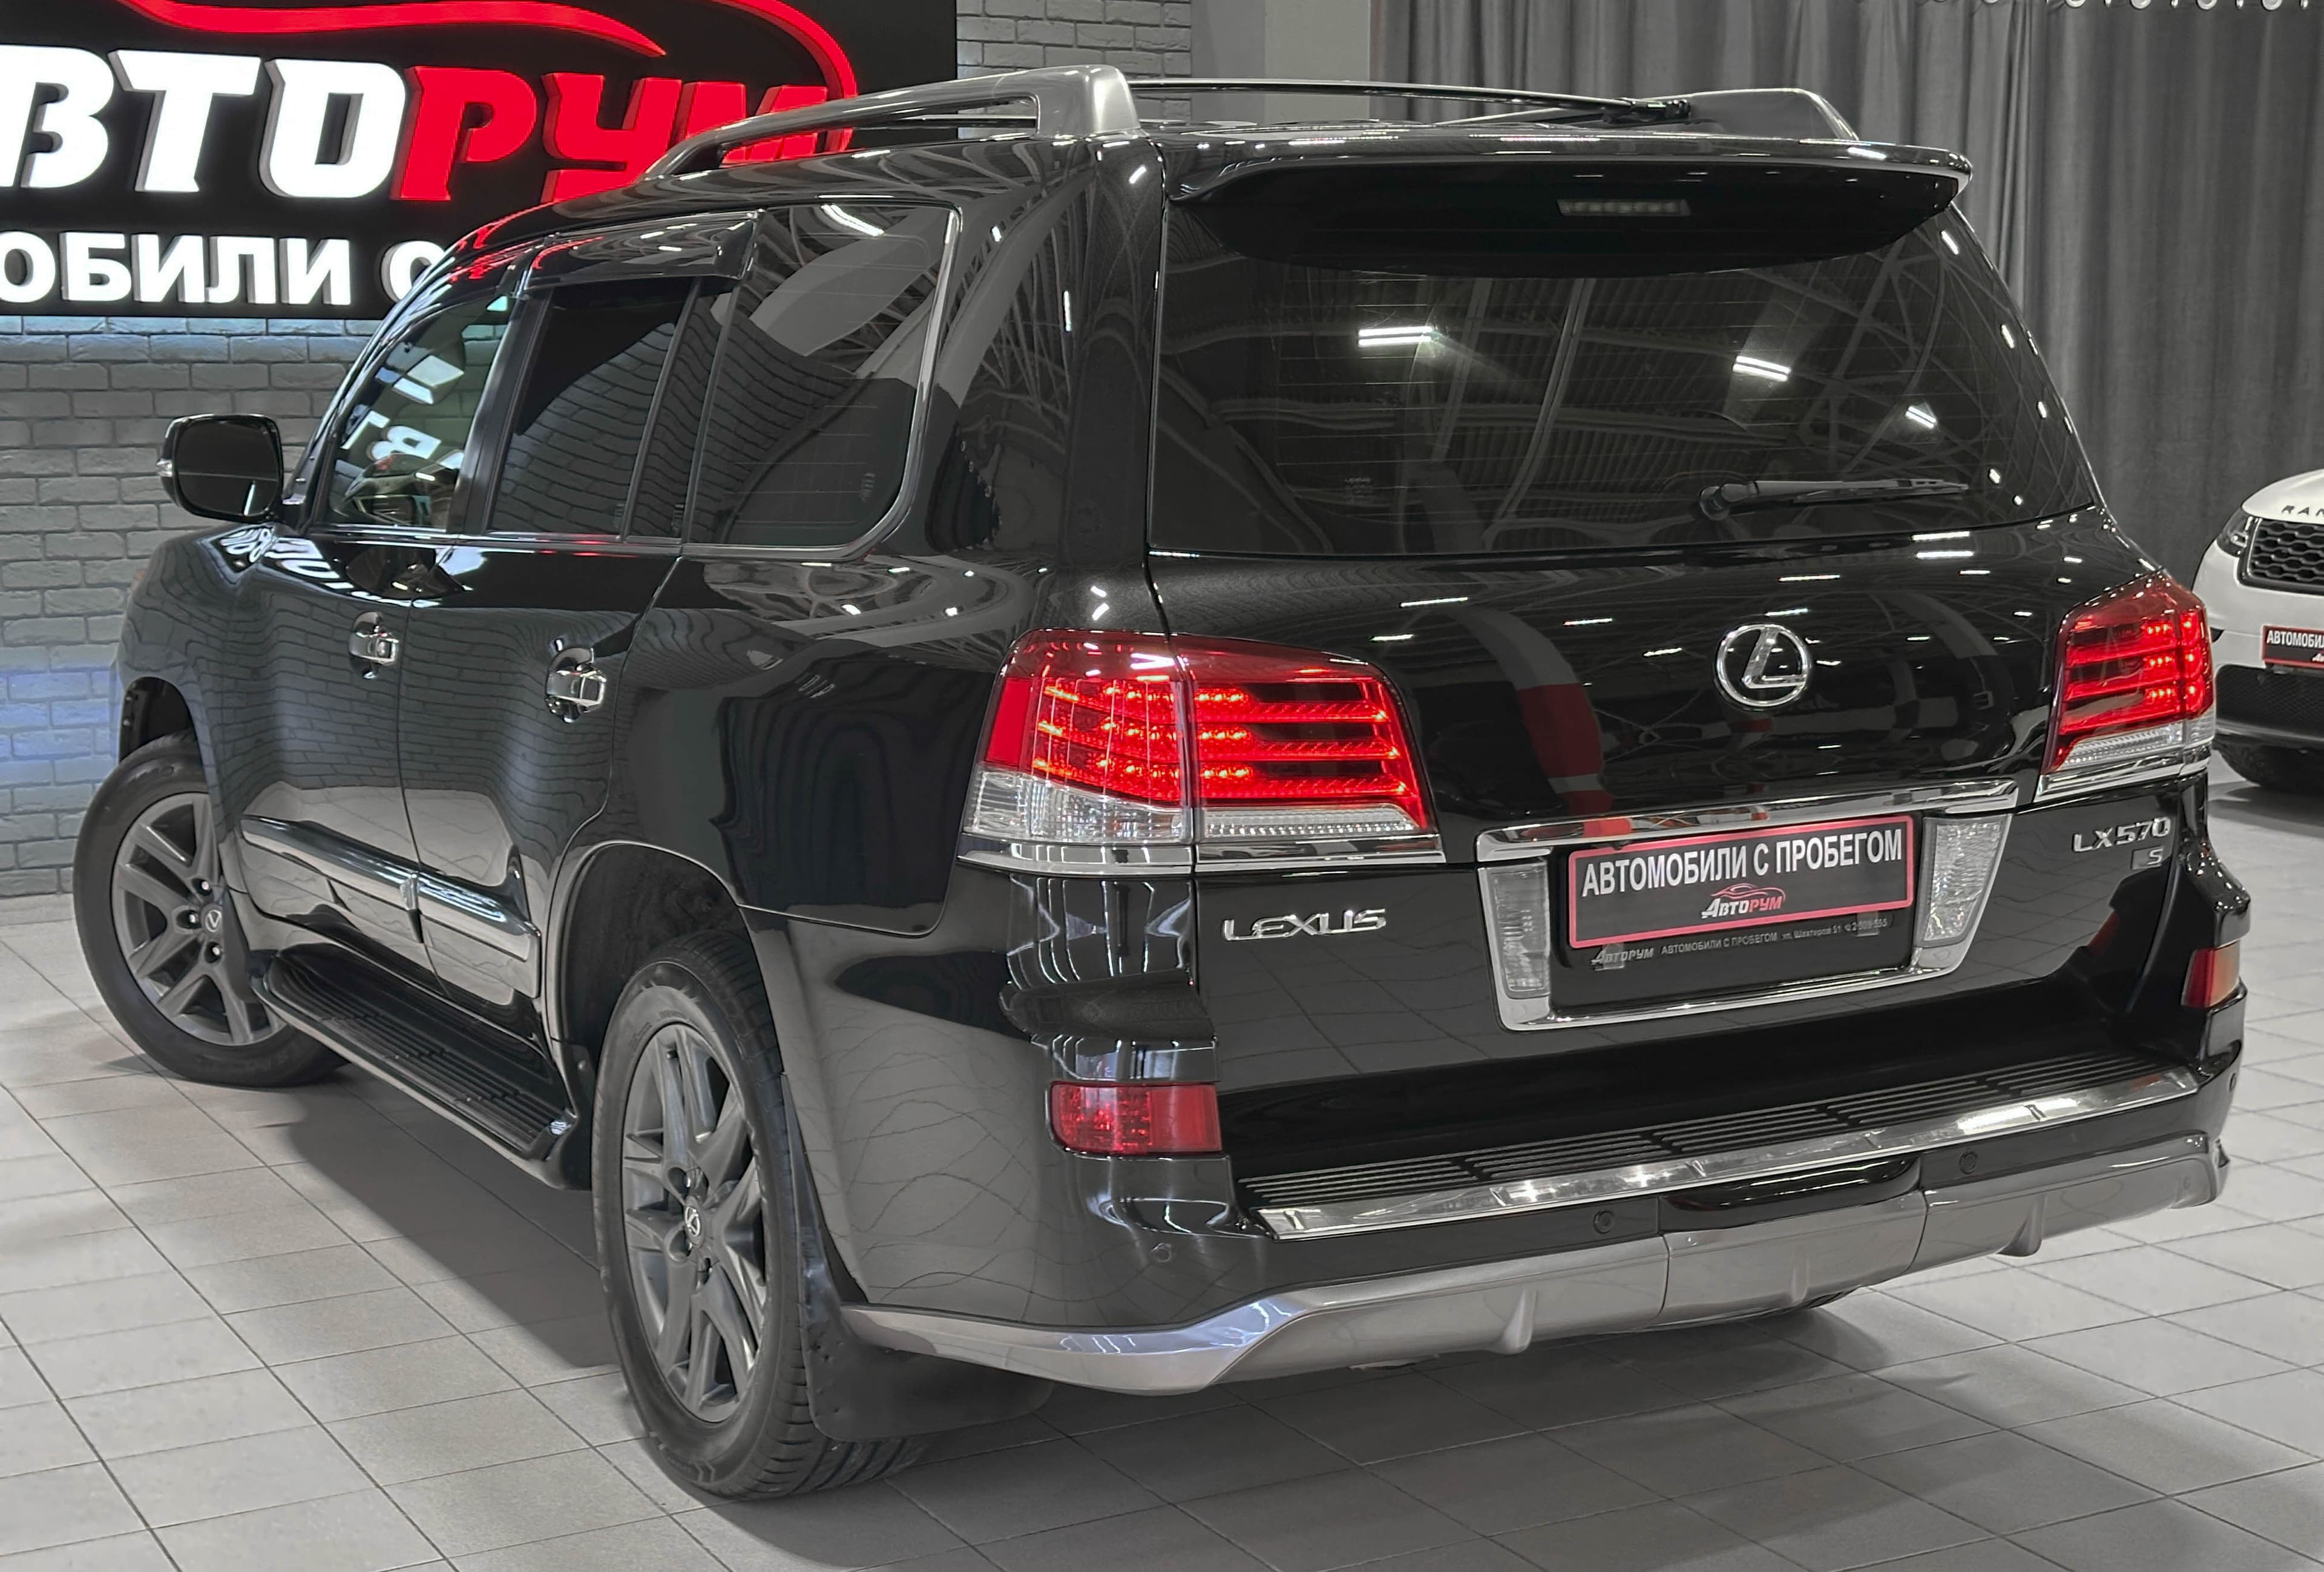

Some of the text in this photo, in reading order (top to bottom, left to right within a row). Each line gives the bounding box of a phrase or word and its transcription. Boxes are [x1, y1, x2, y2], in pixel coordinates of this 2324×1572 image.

[0, 231, 351, 305] ОБИЛИ
[1581, 829, 1902, 898] АВТОМОБИЛИ С ПРОБЕГОМ
[1224, 909, 1387, 941] LEXUS
[1661, 939, 1722, 955] АВТОМОБИЛИ
[1723, 938, 1730, 948] С
[1732, 932, 1778, 947] ПРОБЕГОМ
